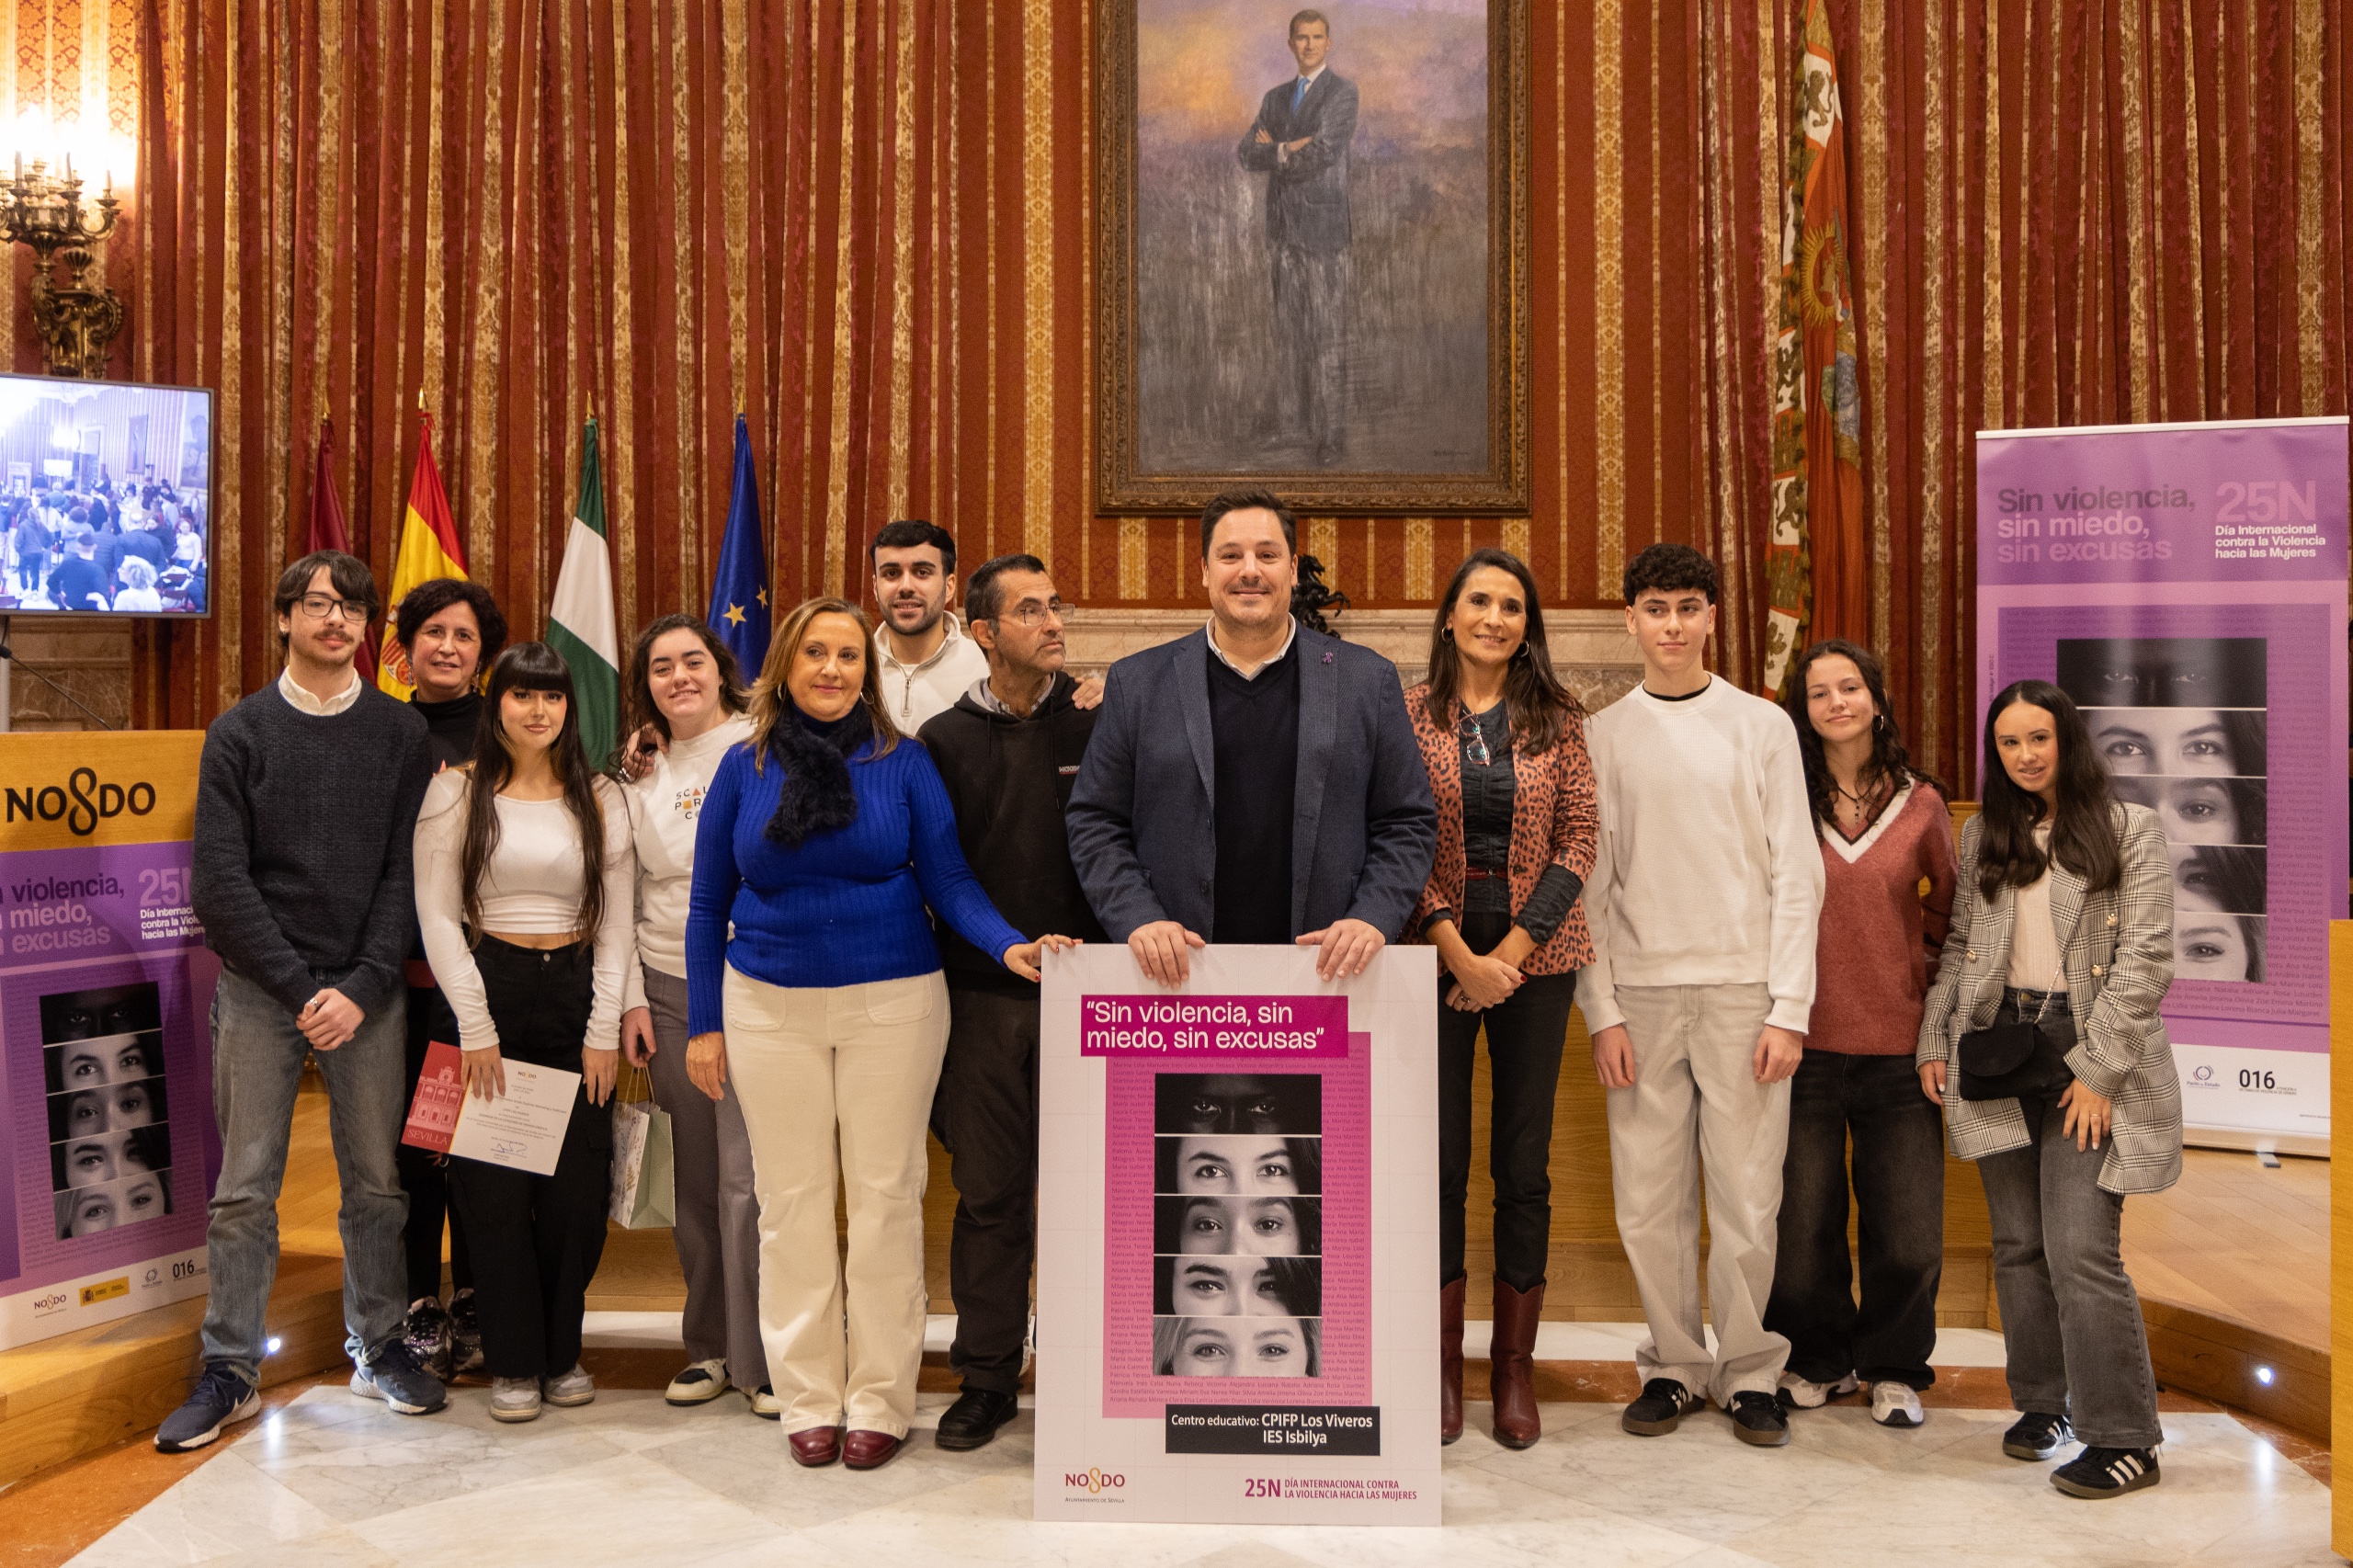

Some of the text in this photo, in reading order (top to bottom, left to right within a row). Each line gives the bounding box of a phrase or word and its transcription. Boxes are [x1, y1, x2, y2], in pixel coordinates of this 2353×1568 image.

[1998, 484, 2196, 513] Sin violencia,
[2216, 480, 2316, 523] 25N
[1997, 510, 2149, 539] sin miedo,
[2215, 524, 2316, 535] Día Internacional
[1997, 538, 2172, 563] sin excusas
[2215, 536, 2326, 547] contra la Violencia
[2215, 547, 2316, 560] hacia las Mujeres
[11, 873, 124, 902] violencia,
[10, 899, 91, 929] miedo,
[140, 905, 193, 918] Día Internaci
[141, 920, 169, 929] contra
[171, 917, 178, 926] la
[142, 926, 206, 939] hacia las Mujere
[12, 926, 110, 954] excusas
[1087, 1001, 1292, 1026] “Sin violencia, sin
[1087, 1026, 1324, 1052] miedo, sin excusas”
[2239, 1069, 2275, 1089] 016
[407, 1130, 447, 1145] SEVILLA
[173, 1260, 194, 1277] 016
[1172, 1413, 1373, 1427] Centro educativo: CPIFP Los Viveros
[1263, 1429, 1327, 1447] IES Isbilya
[1245, 1477, 1399, 1497] 25N DÍA INTERNACIONAL CONTRA
[1285, 1490, 1417, 1501] LA VIOLENCIA HACIA LAS MUJERES
